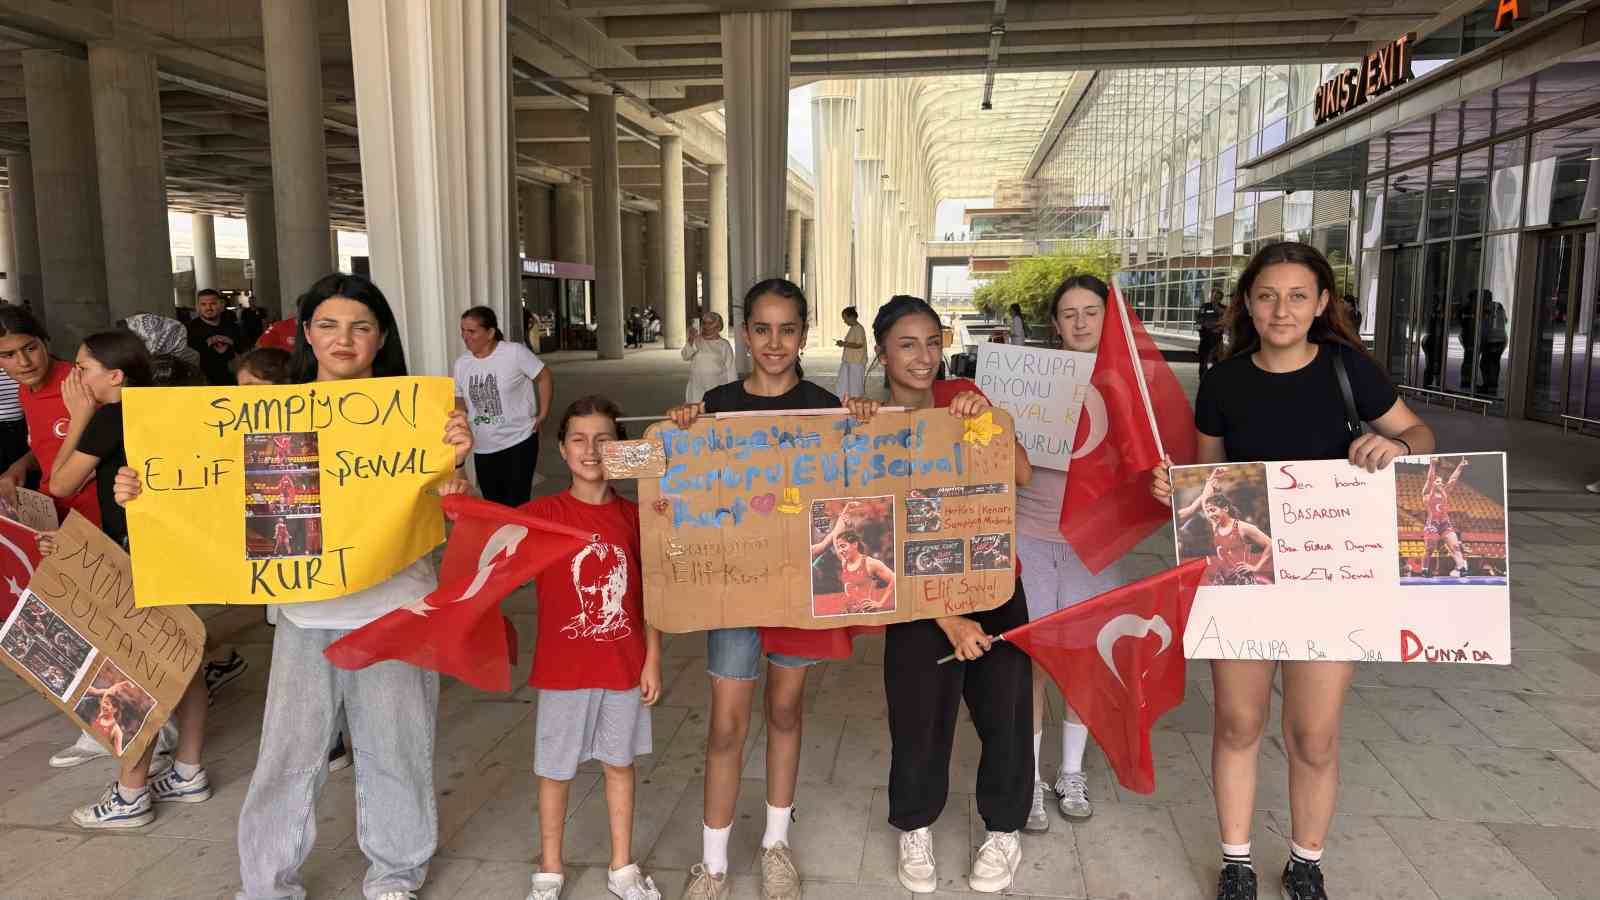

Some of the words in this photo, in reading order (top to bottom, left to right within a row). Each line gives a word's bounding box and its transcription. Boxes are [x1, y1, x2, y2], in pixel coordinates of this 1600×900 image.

[985, 351, 1076, 377] AVRUPA
[203, 383, 420, 438] ŞAMPİYON
[144, 455, 235, 492] ELİF
[250, 546, 356, 597] KURT
[44, 572, 168, 689] SULTANI
